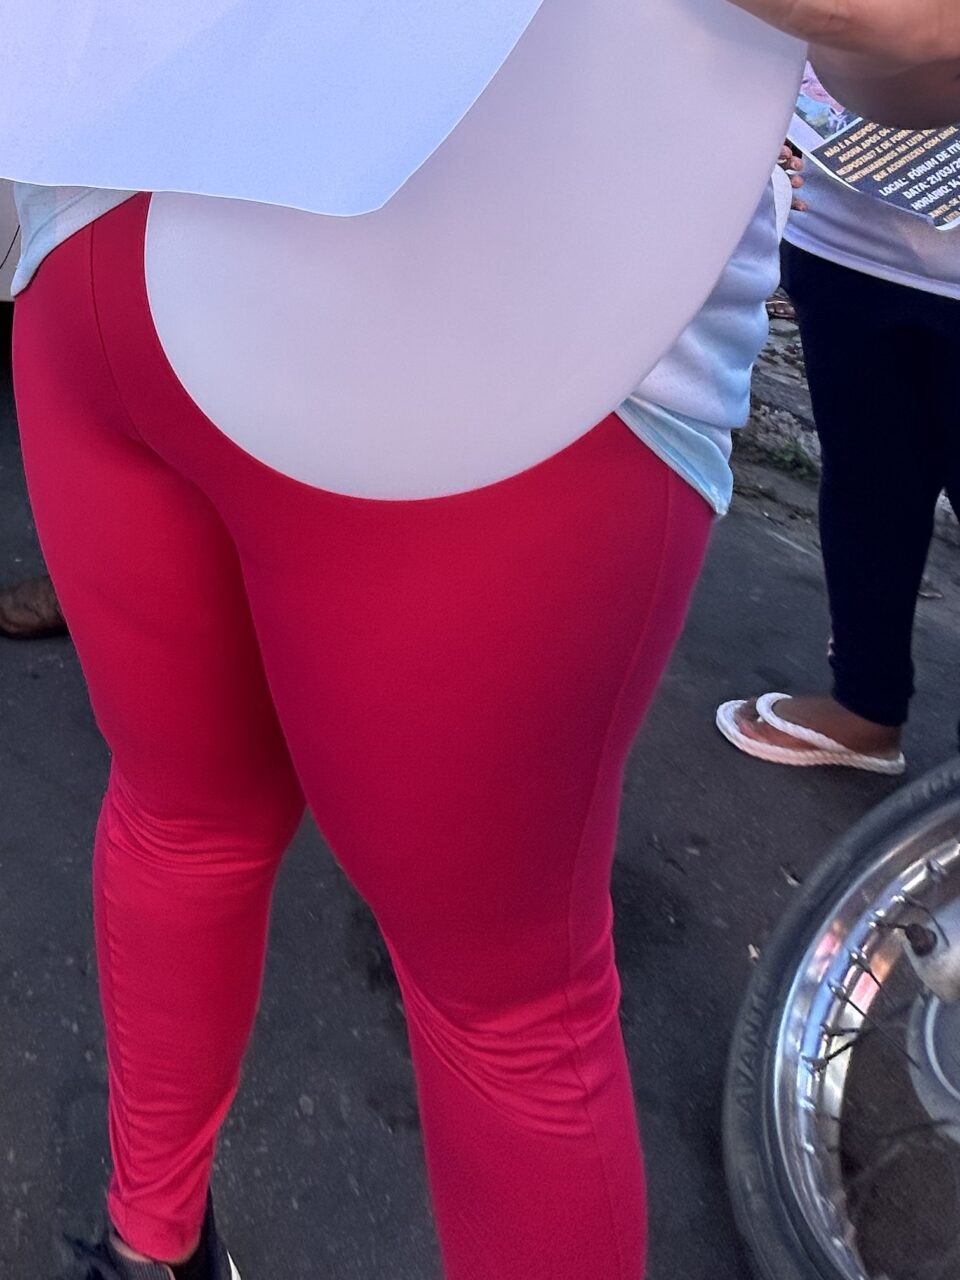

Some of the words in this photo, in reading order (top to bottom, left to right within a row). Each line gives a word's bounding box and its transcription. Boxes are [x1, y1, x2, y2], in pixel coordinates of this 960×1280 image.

[878, 177, 910, 197] LOCAL:
[935, 150, 951, 163] DE
[902, 181, 931, 200] DATA:
[910, 184, 953, 211] HORÁRIO:
